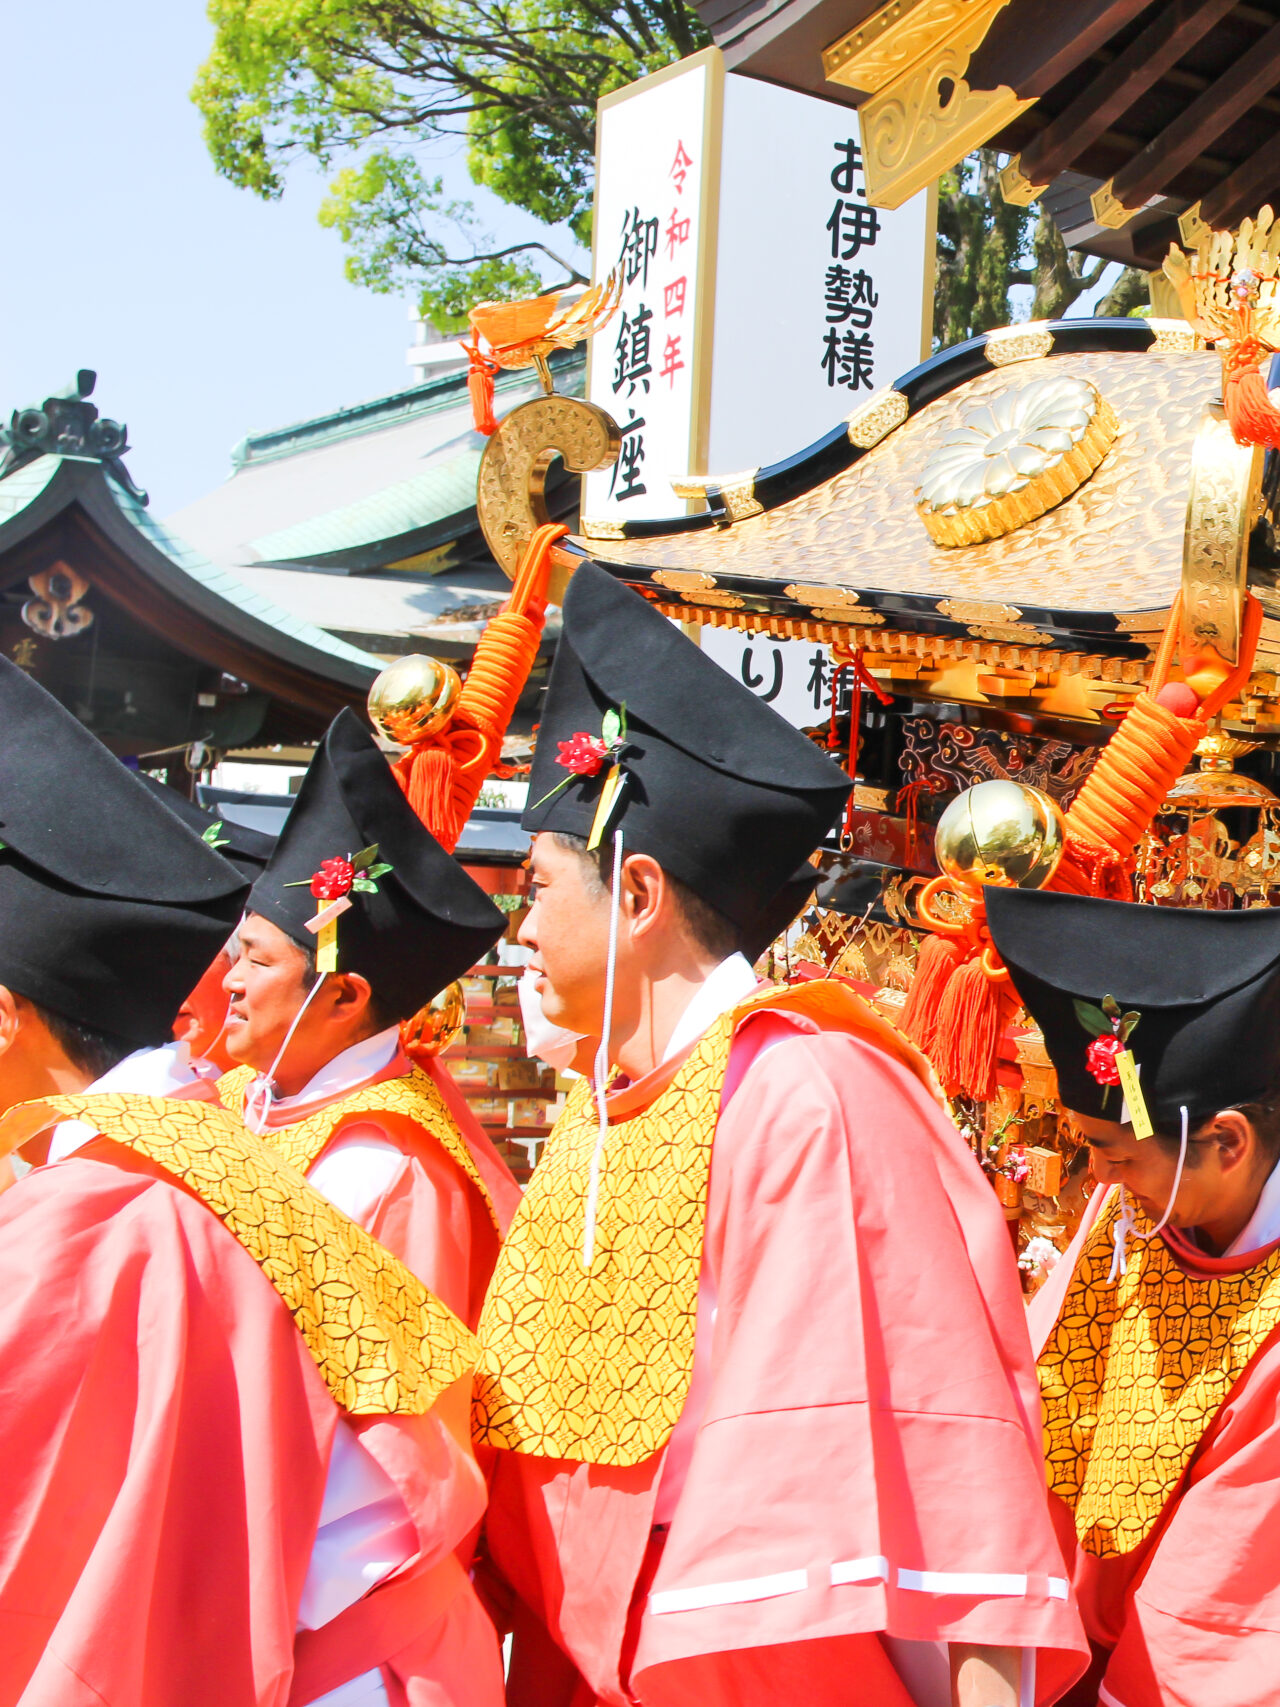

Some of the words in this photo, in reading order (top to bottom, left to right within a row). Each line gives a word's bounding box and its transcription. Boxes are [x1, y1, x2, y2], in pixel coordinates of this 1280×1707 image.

[607, 206, 659, 502] 御鎮座
[659, 139, 694, 391] 令和四年
[821, 138, 881, 392] お伊勢様
